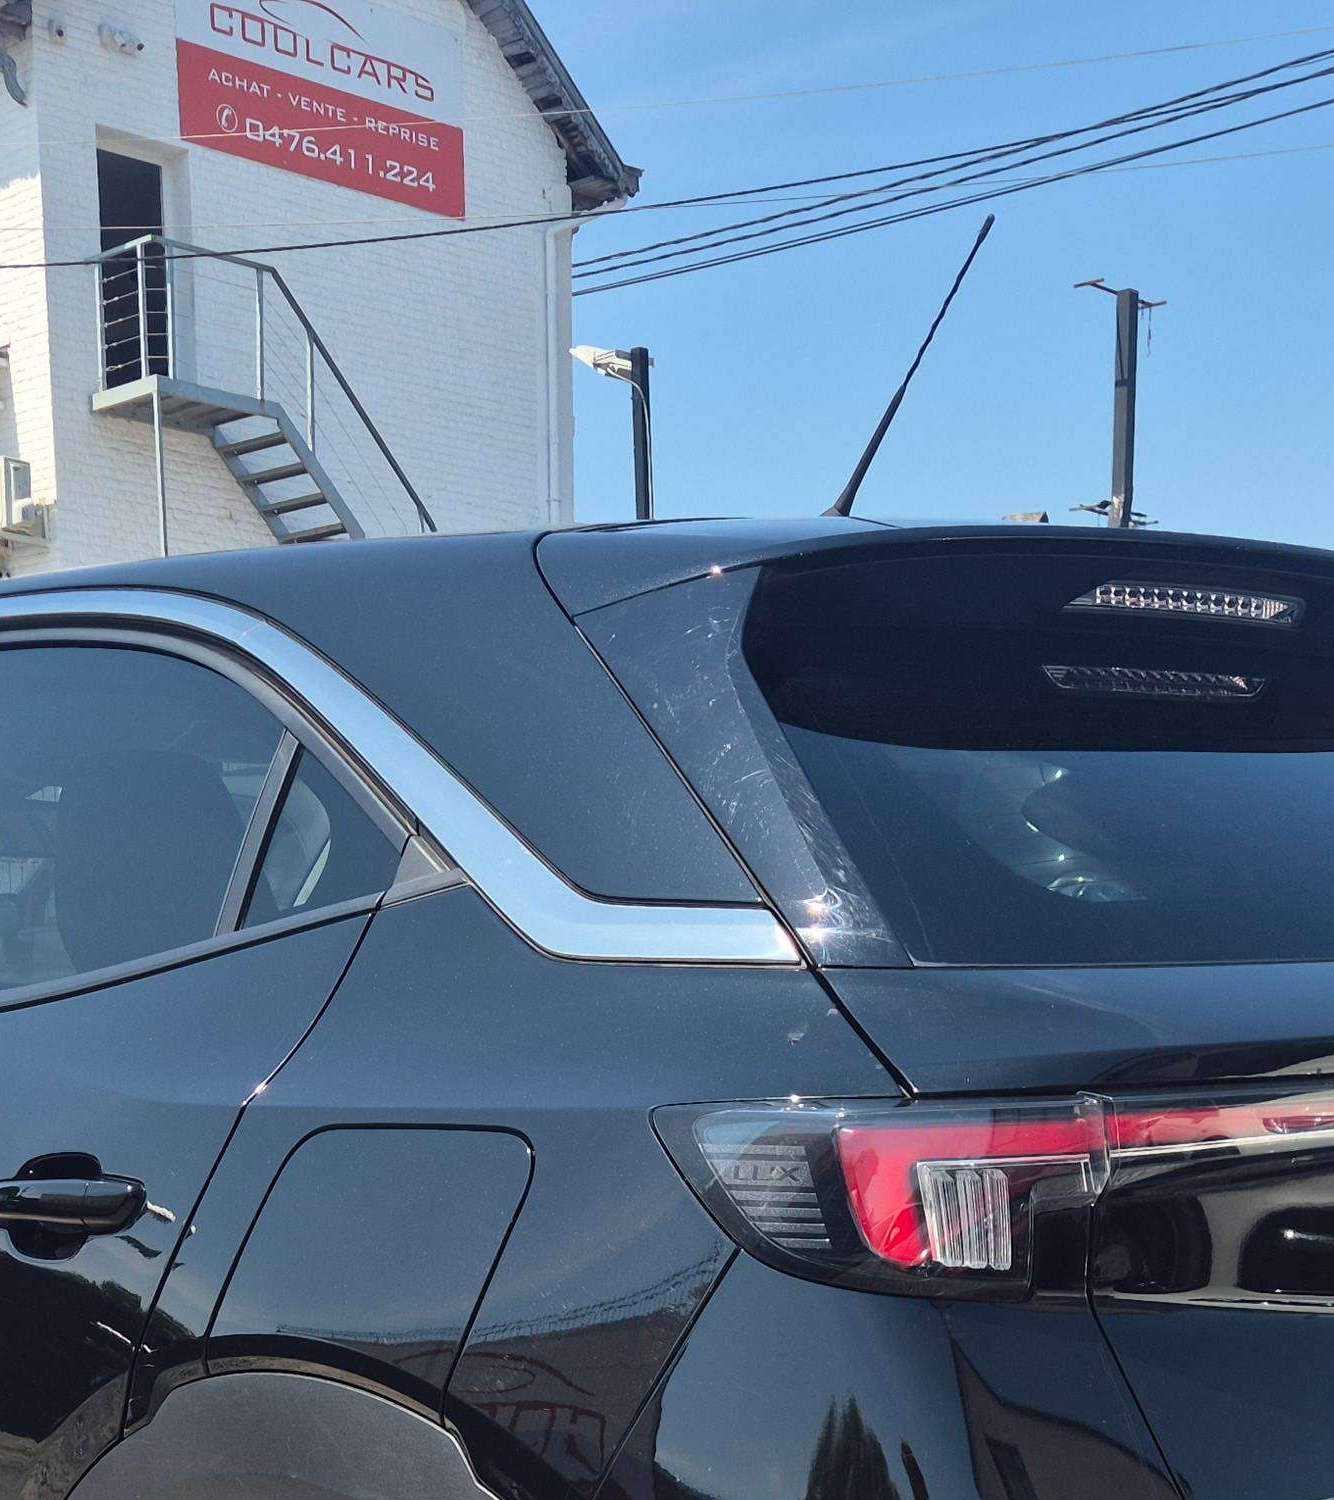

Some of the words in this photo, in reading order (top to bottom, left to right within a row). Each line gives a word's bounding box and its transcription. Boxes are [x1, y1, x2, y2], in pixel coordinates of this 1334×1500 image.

[208, 68, 271, 98] ACHAT
[287, 92, 347, 123] VENTE
[365, 116, 440, 151] REPRISE
[245, 117, 437, 193] 0476.411.224
